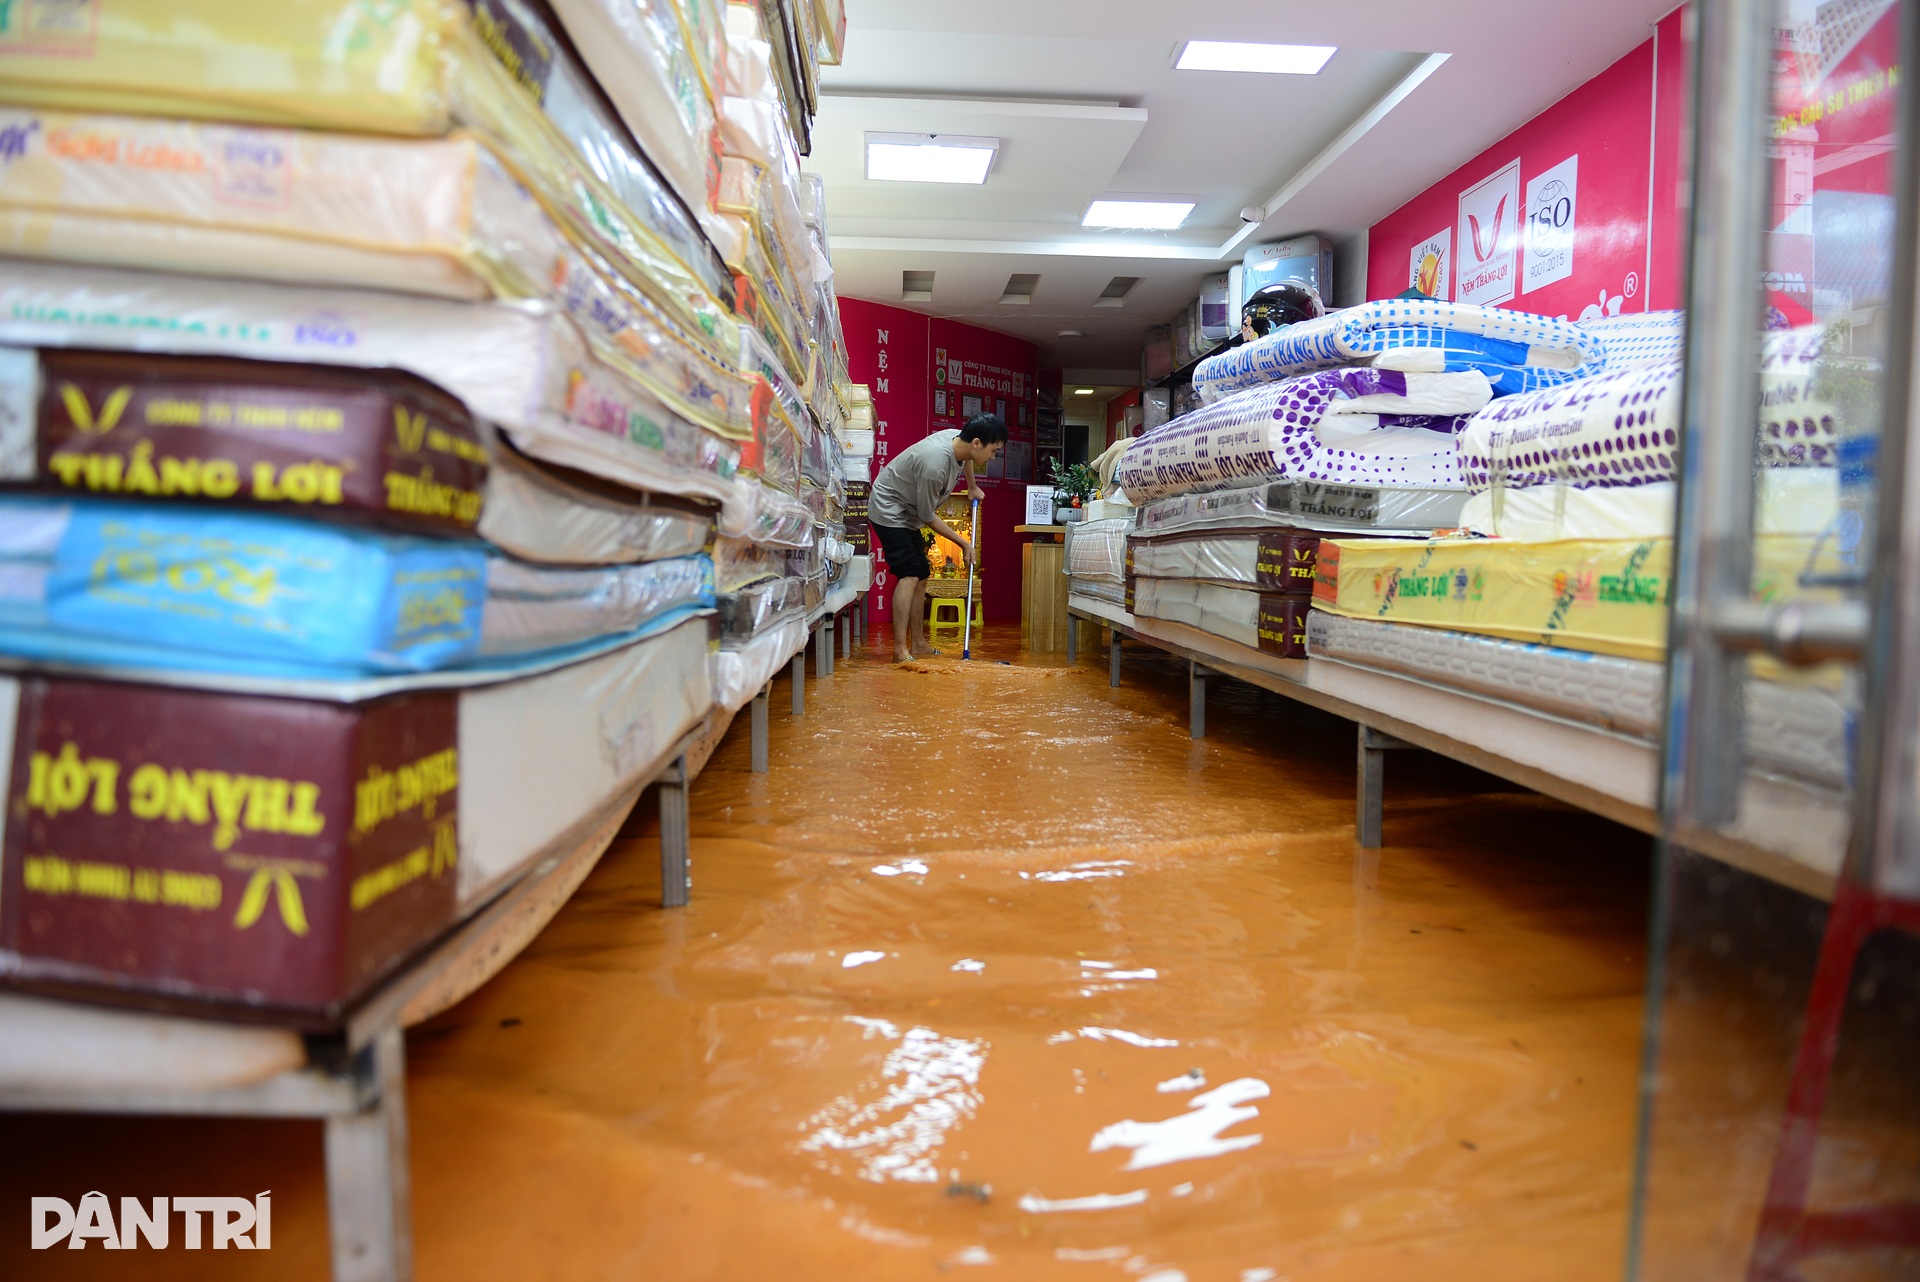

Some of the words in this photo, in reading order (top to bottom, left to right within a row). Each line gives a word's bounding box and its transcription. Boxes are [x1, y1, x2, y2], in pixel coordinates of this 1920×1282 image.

[1529, 197, 1571, 241] ISO
[1530, 253, 1565, 279] 9001:2015
[964, 371, 996, 390] THẮNG
[997, 379, 1011, 395] LỢI
[49, 438, 241, 497] THẮNG
[1300, 500, 1347, 517] THẮNG
[129, 761, 326, 852] THẮNG
